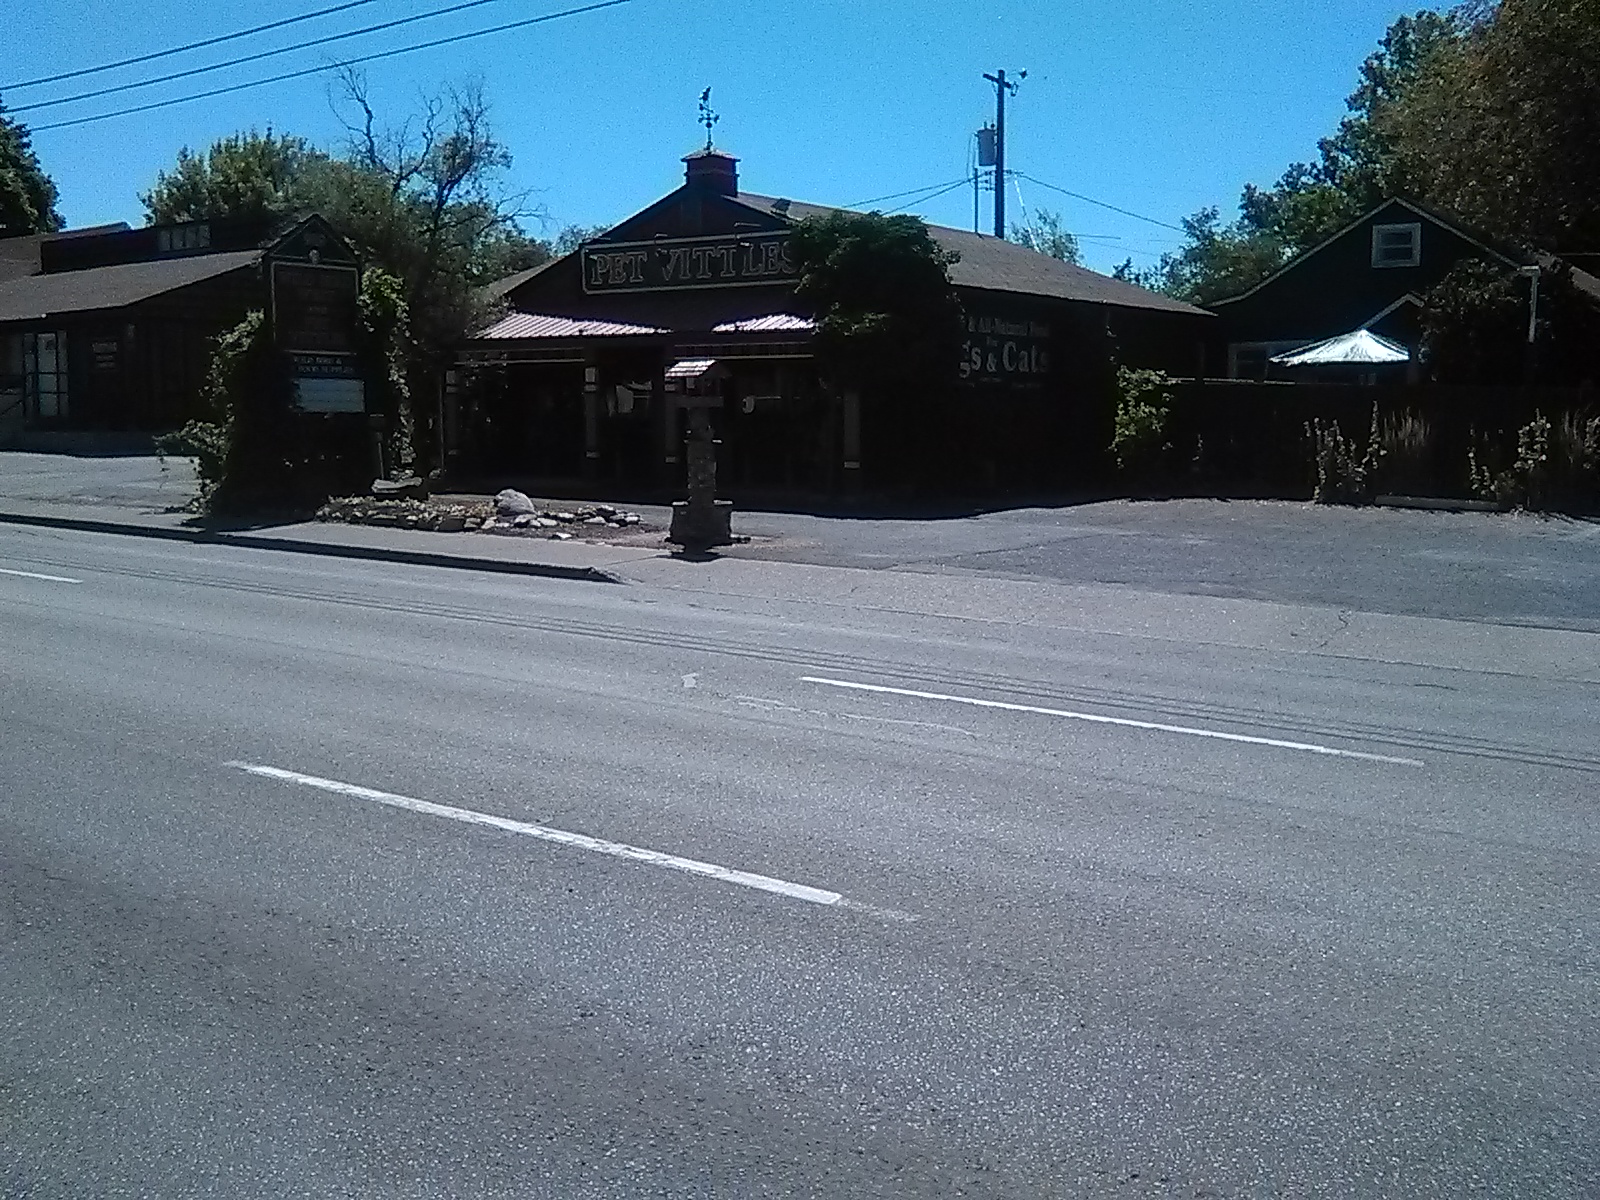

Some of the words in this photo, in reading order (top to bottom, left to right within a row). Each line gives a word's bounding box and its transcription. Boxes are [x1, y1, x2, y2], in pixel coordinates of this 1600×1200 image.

[590, 251, 648, 285] PET
[656, 241, 799, 283] VITTLES
[986, 352, 998, 373] &
[1002, 341, 1049, 373] Cats
